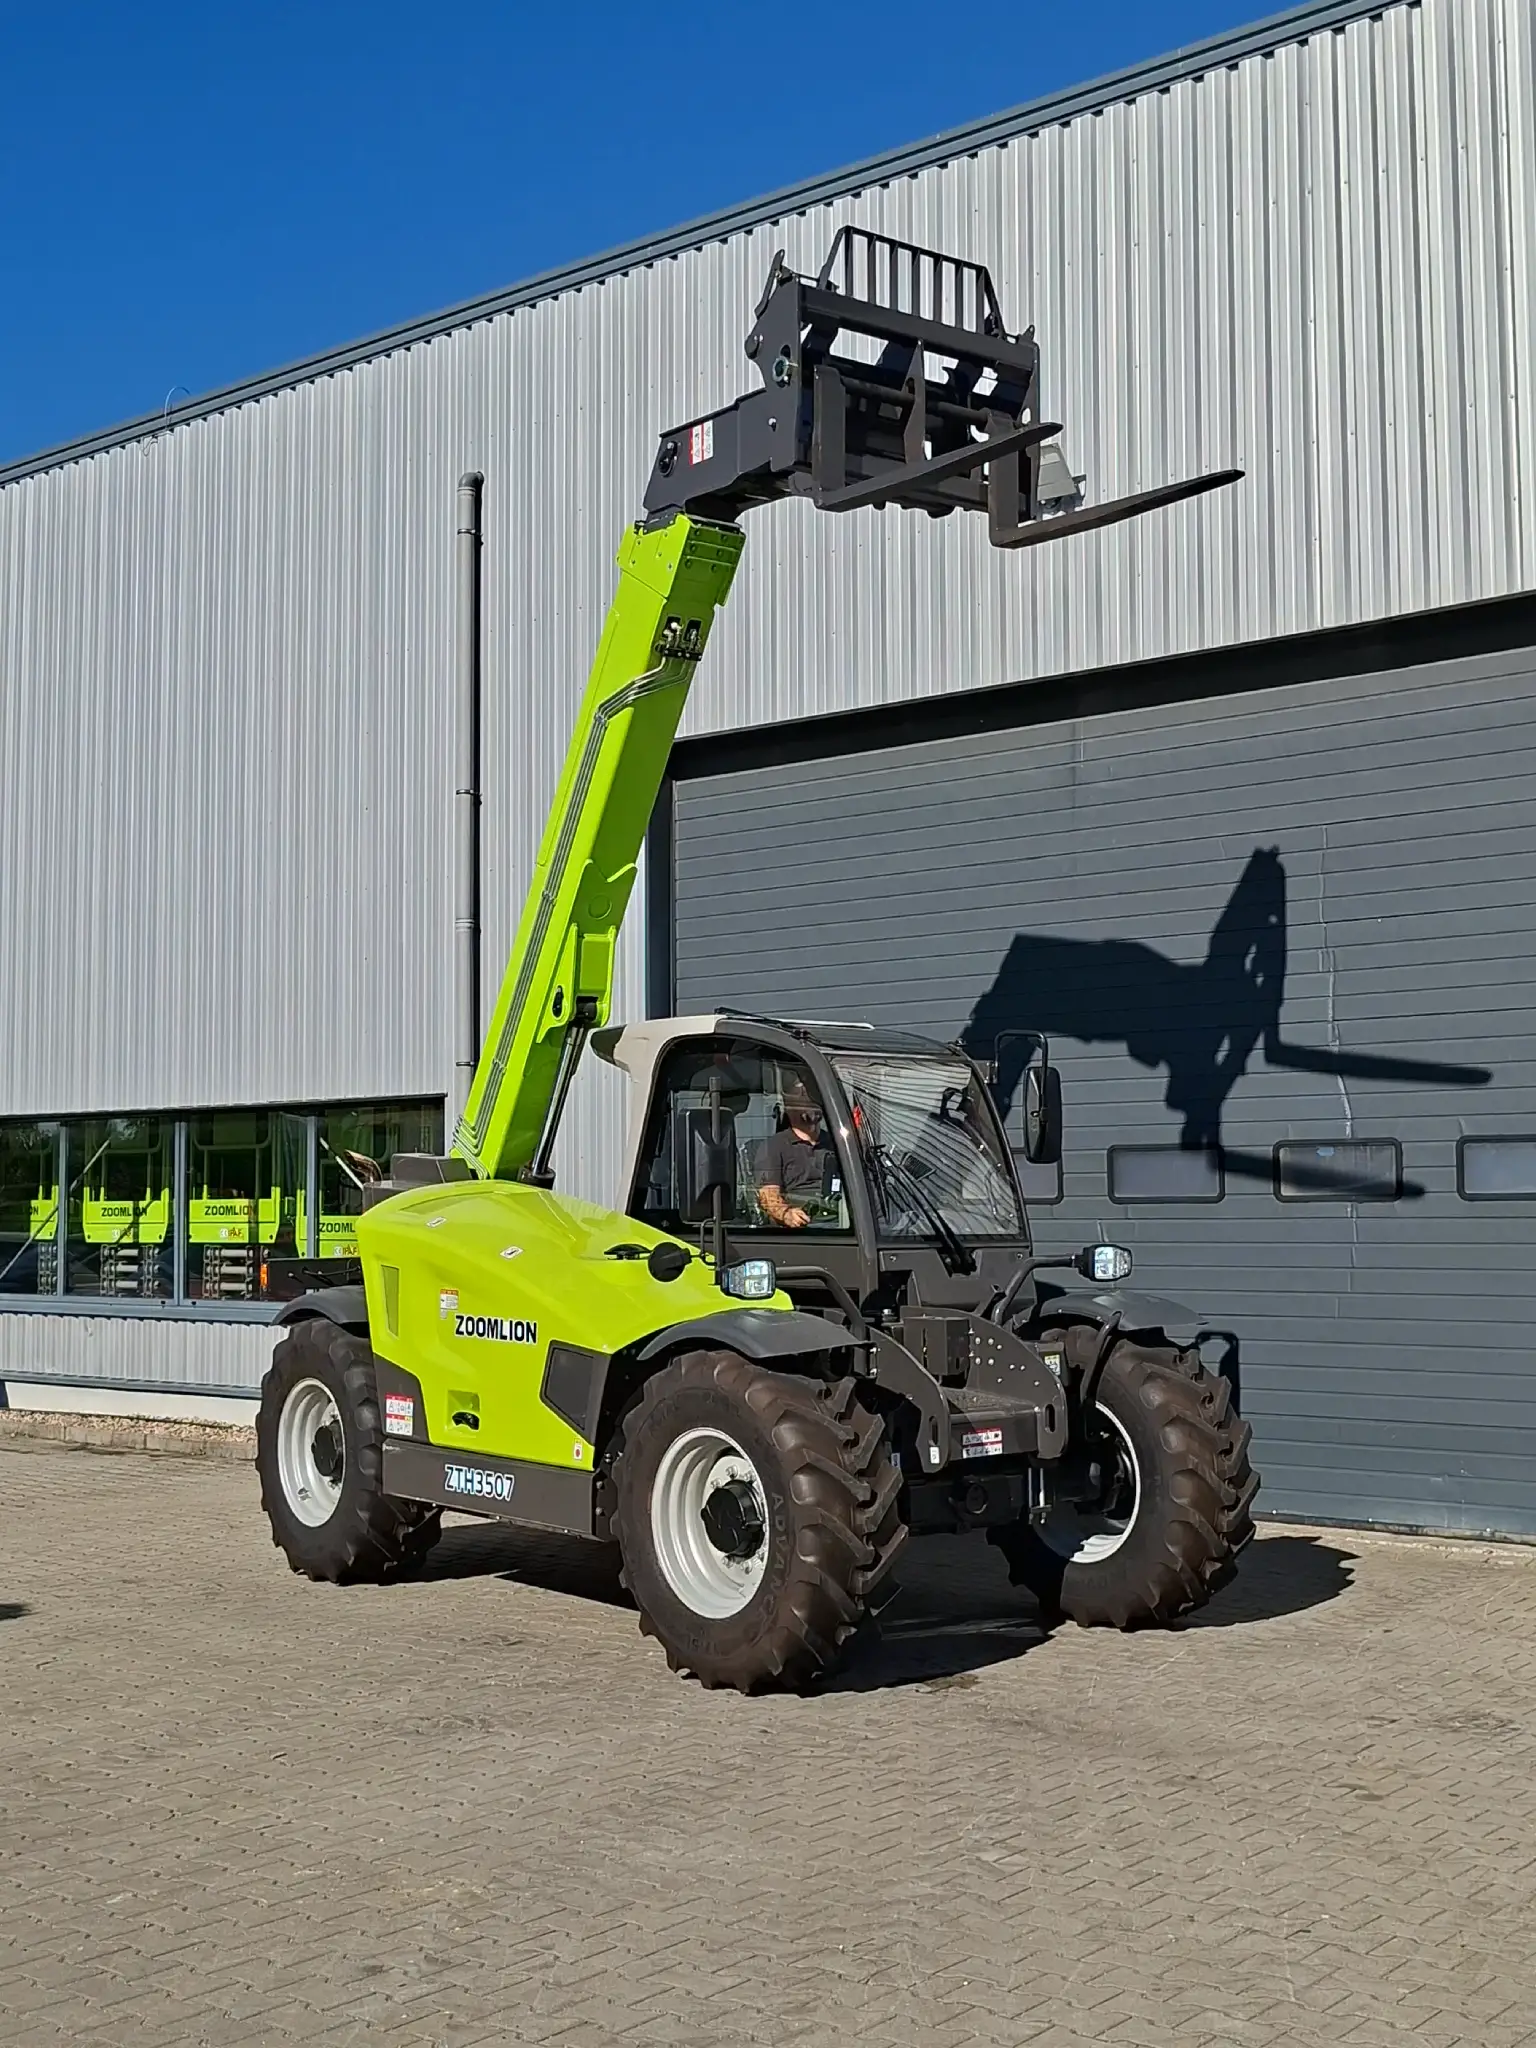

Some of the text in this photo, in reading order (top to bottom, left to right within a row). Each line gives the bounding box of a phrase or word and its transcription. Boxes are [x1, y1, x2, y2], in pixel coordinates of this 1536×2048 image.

[320, 1222, 356, 1233] ZOOML
[455, 1314, 538, 1344] ZOOMLION
[446, 1465, 514, 1501] ZTH3507
